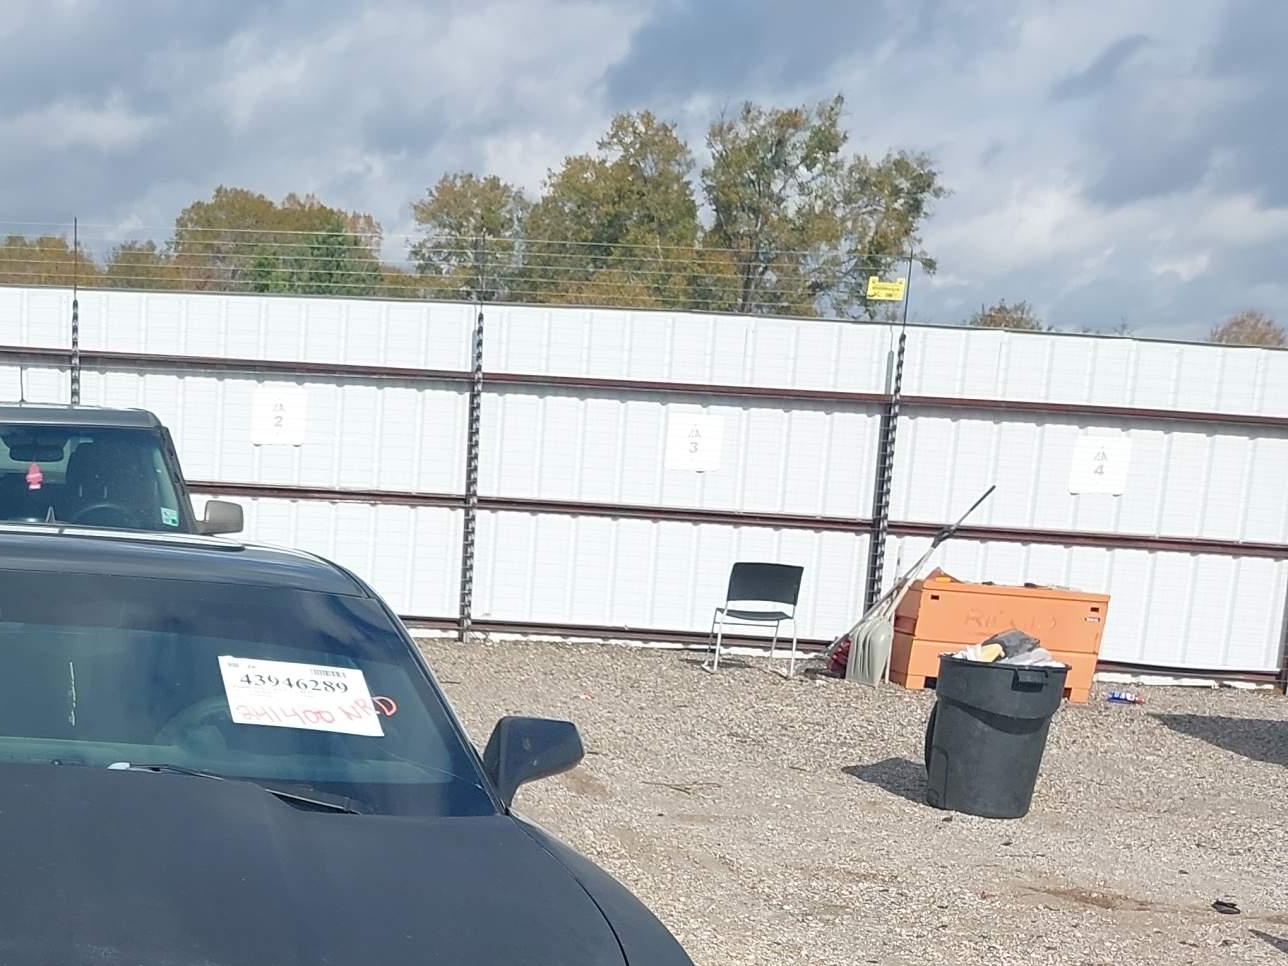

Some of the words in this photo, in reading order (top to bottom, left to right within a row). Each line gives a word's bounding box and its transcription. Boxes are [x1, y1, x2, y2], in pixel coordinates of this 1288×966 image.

[273, 415, 284, 428] 2
[688, 441, 698, 454] 3
[1093, 464, 1105, 476] 4
[239, 672, 349, 694] 43946289
